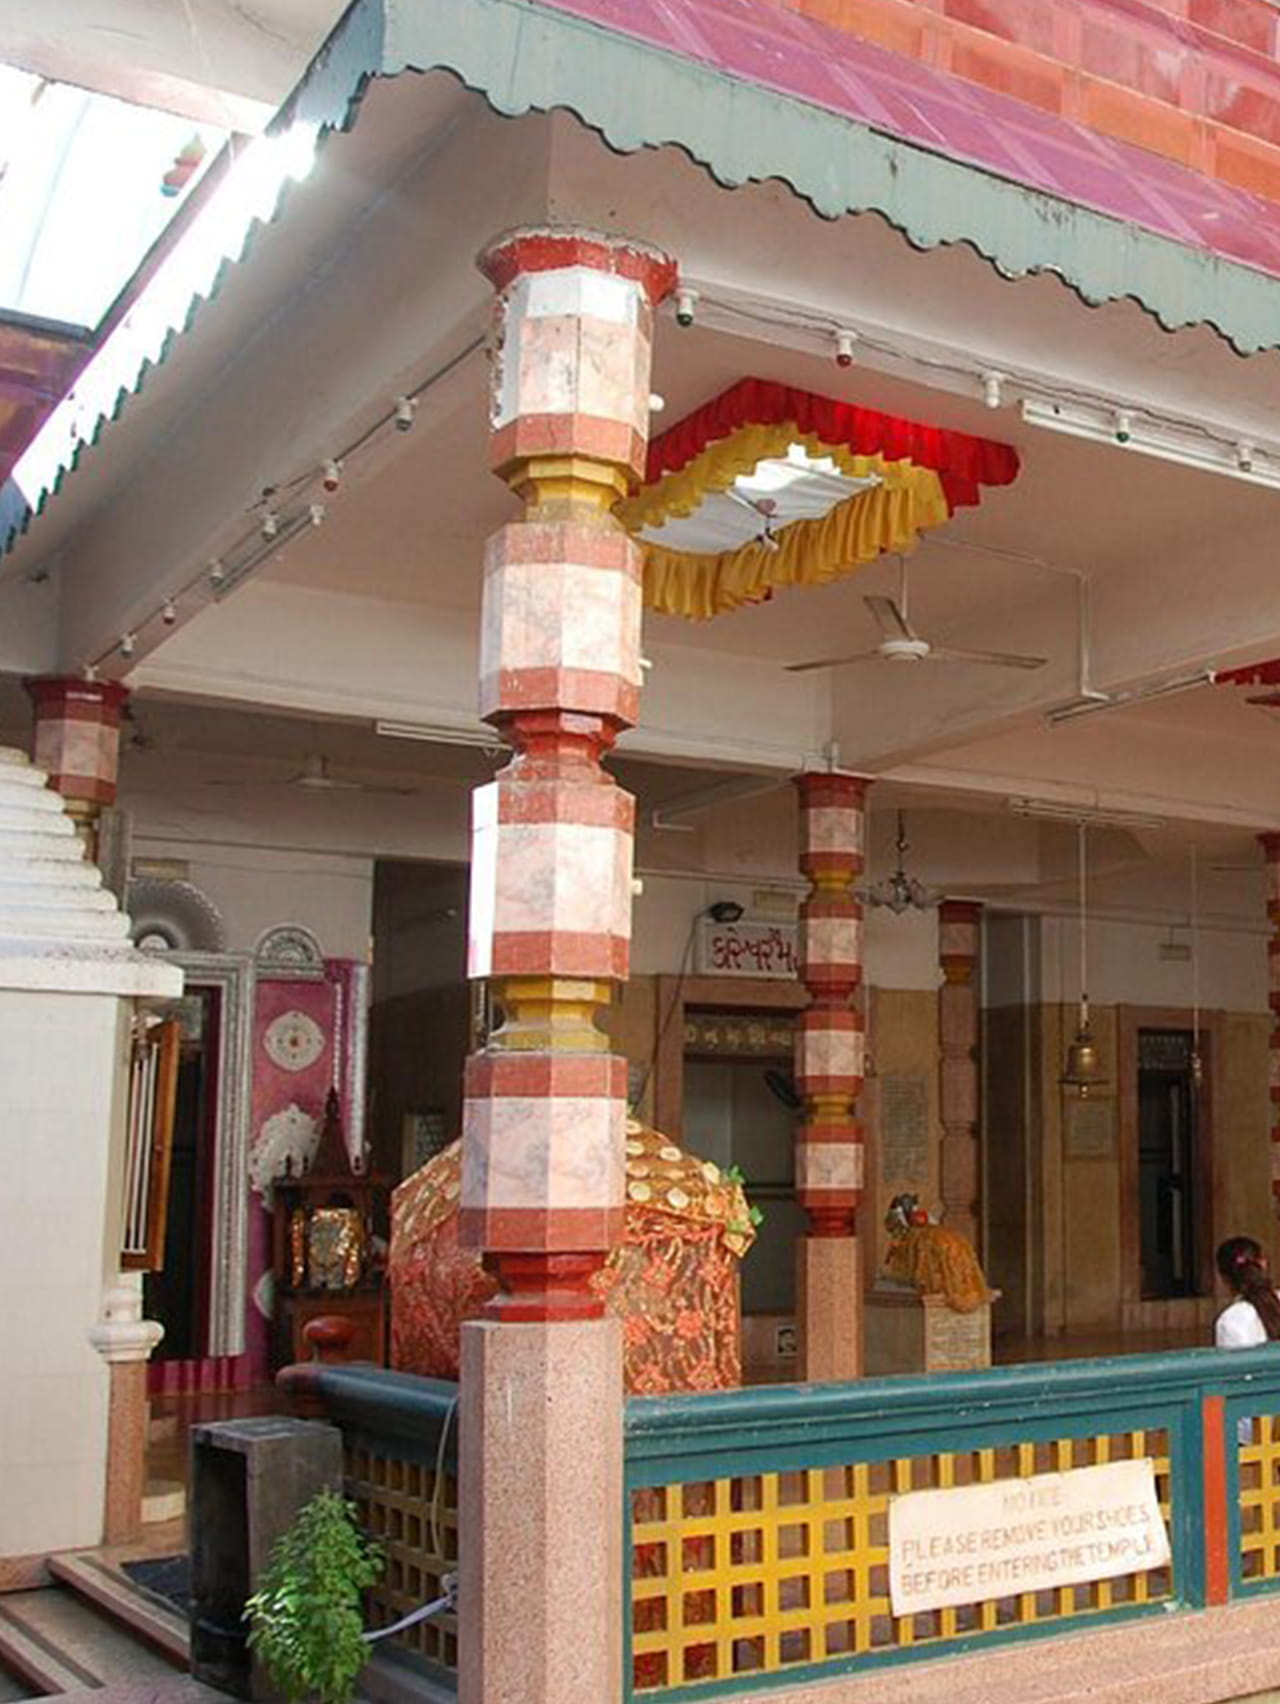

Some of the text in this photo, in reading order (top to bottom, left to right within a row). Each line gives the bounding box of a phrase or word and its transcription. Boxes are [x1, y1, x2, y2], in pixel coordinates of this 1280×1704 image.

[902, 1503, 1151, 1562] PLEASE REMOVE YOUR SHOES
[901, 1533, 1154, 1597] BEFORE ENTERING THE TEMPLE
